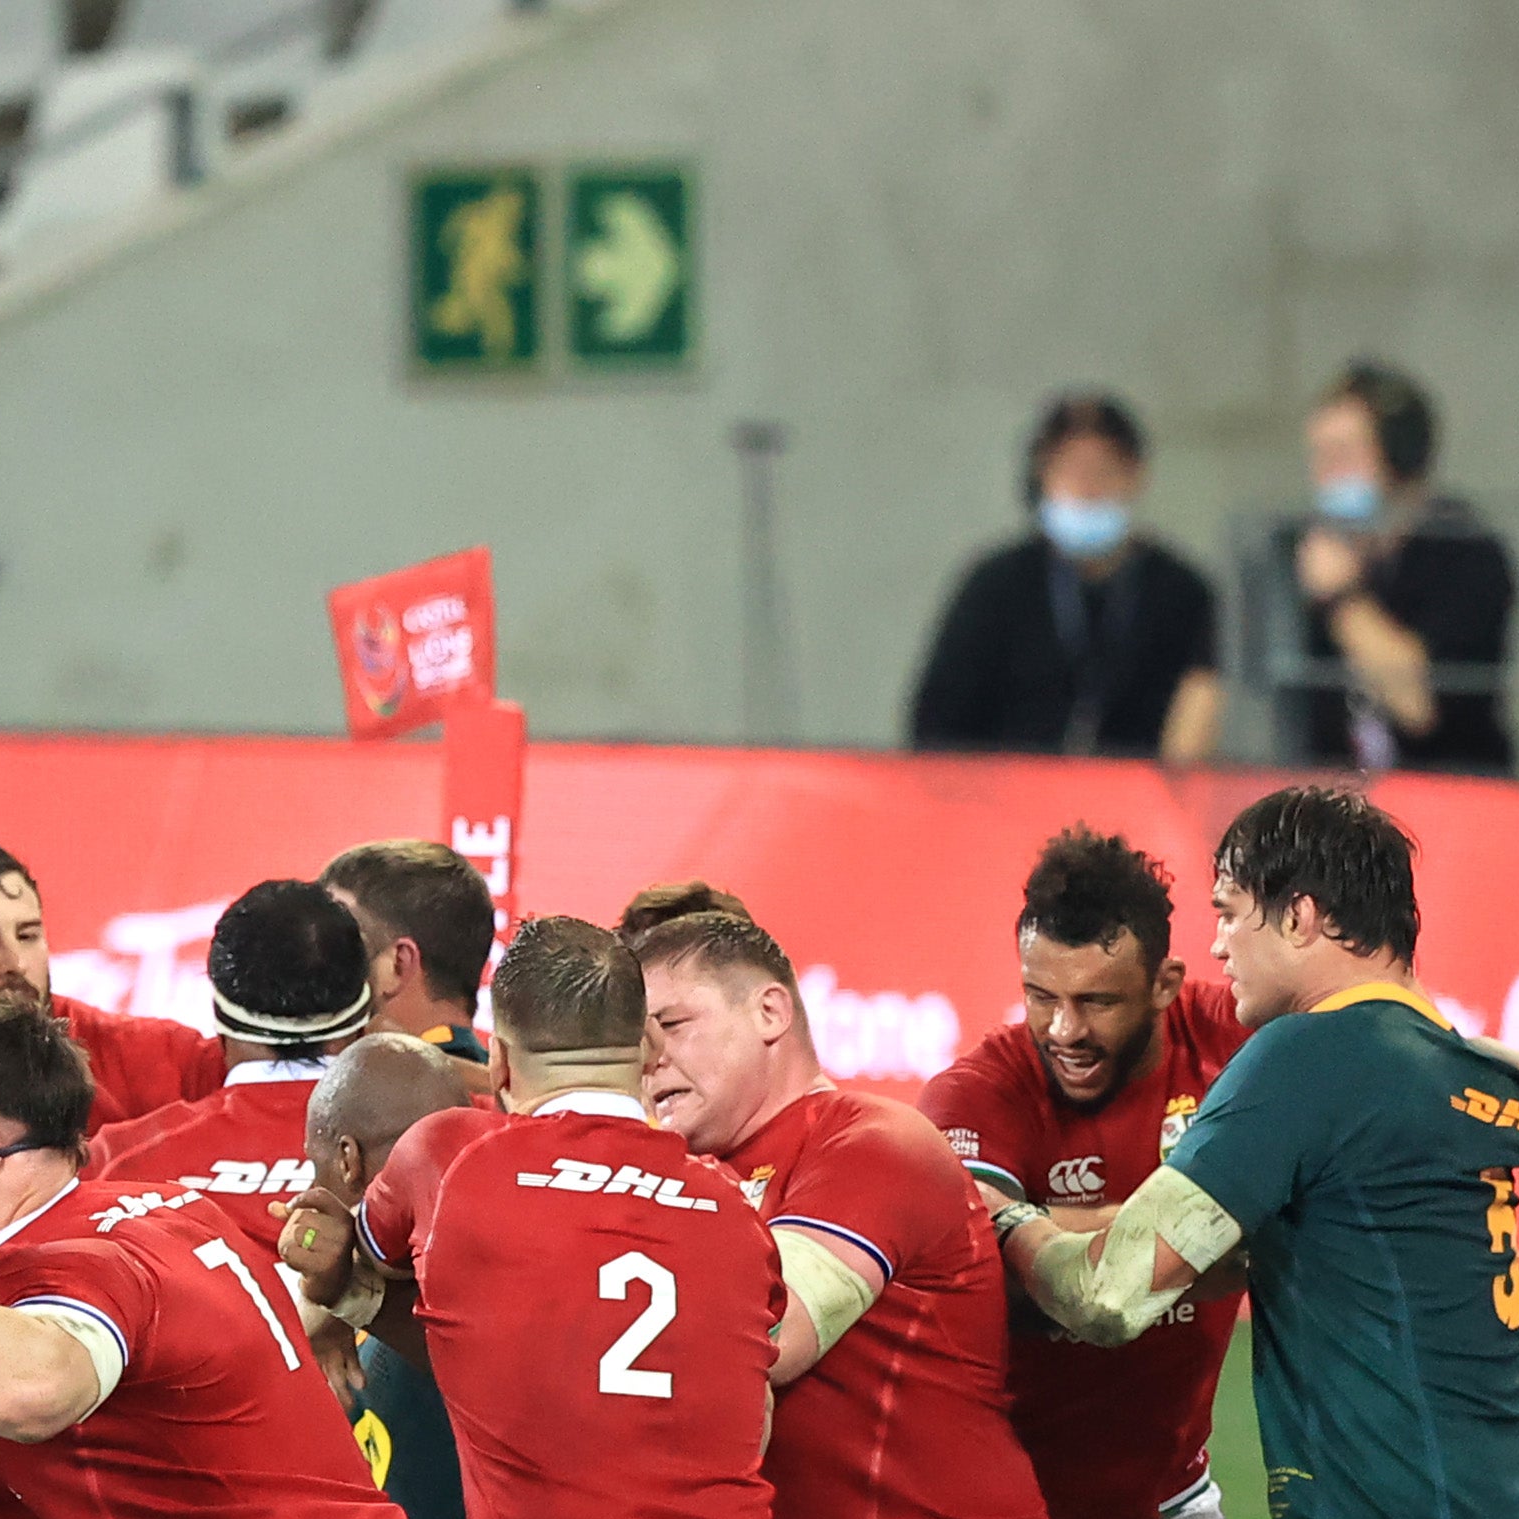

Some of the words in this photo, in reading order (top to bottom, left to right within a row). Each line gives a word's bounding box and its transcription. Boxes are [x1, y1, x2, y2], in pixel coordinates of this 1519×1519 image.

[944, 1128, 980, 1140] ASTLE
[950, 1140, 980, 1152] ONS
[208, 1159, 316, 1194] DH
[547, 1157, 697, 1210] DHL
[598, 1251, 677, 1398] 2
